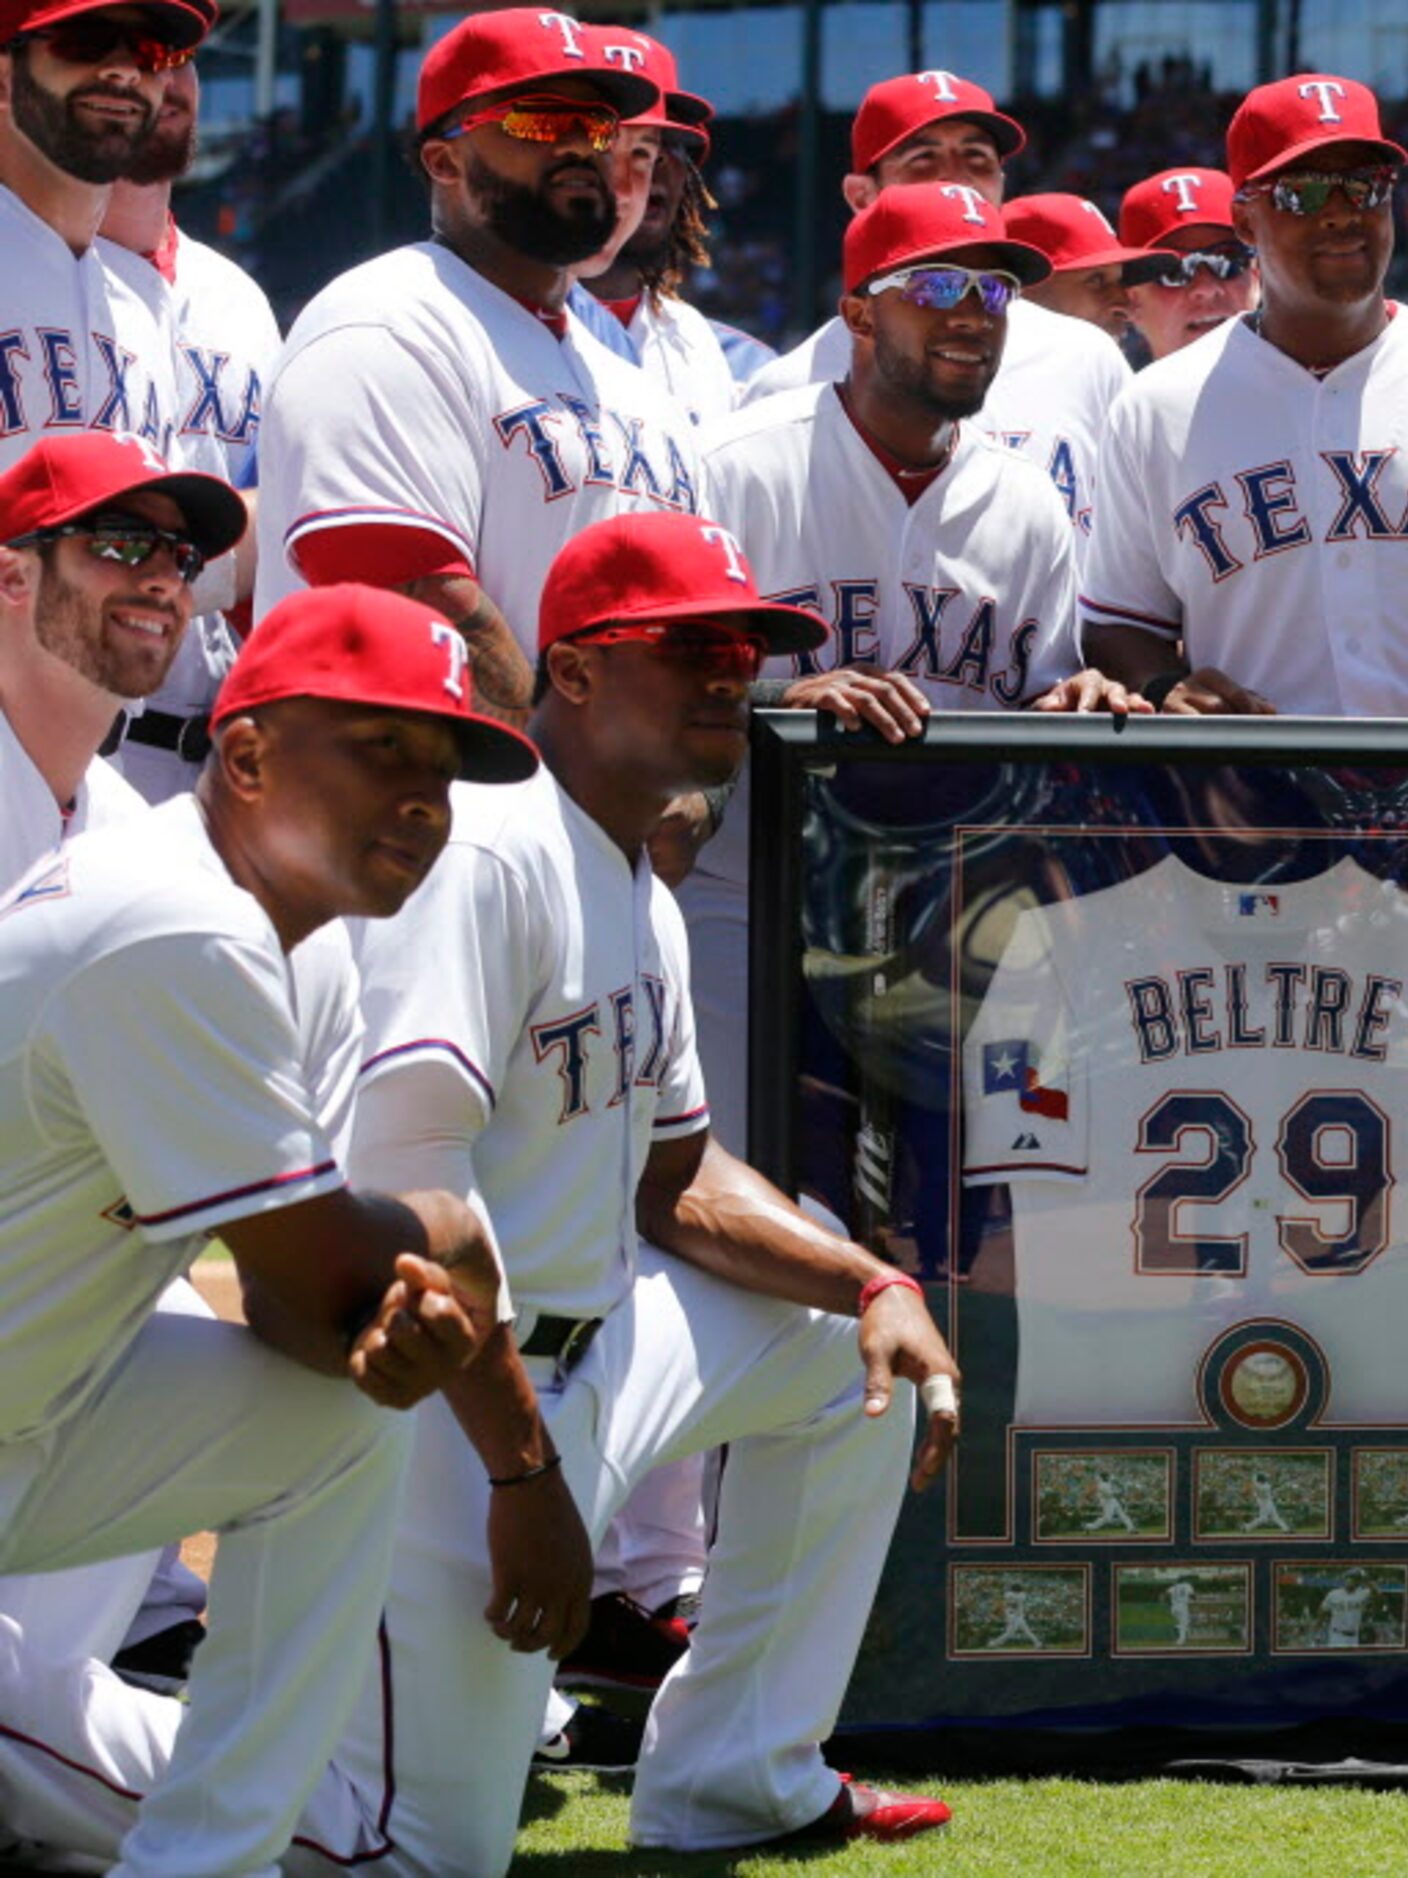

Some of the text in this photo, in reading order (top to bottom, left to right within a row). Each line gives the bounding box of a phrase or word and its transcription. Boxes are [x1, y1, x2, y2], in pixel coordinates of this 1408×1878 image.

[538, 12, 584, 60] T
[916, 69, 962, 104] T
[1297, 80, 1347, 124] T
[939, 183, 987, 228] T
[1160, 173, 1203, 213] T
[700, 526, 748, 587] T
[430, 620, 469, 699] T
[1124, 961, 1403, 1064] BELTRE
[1129, 1087, 1398, 1279] 29
